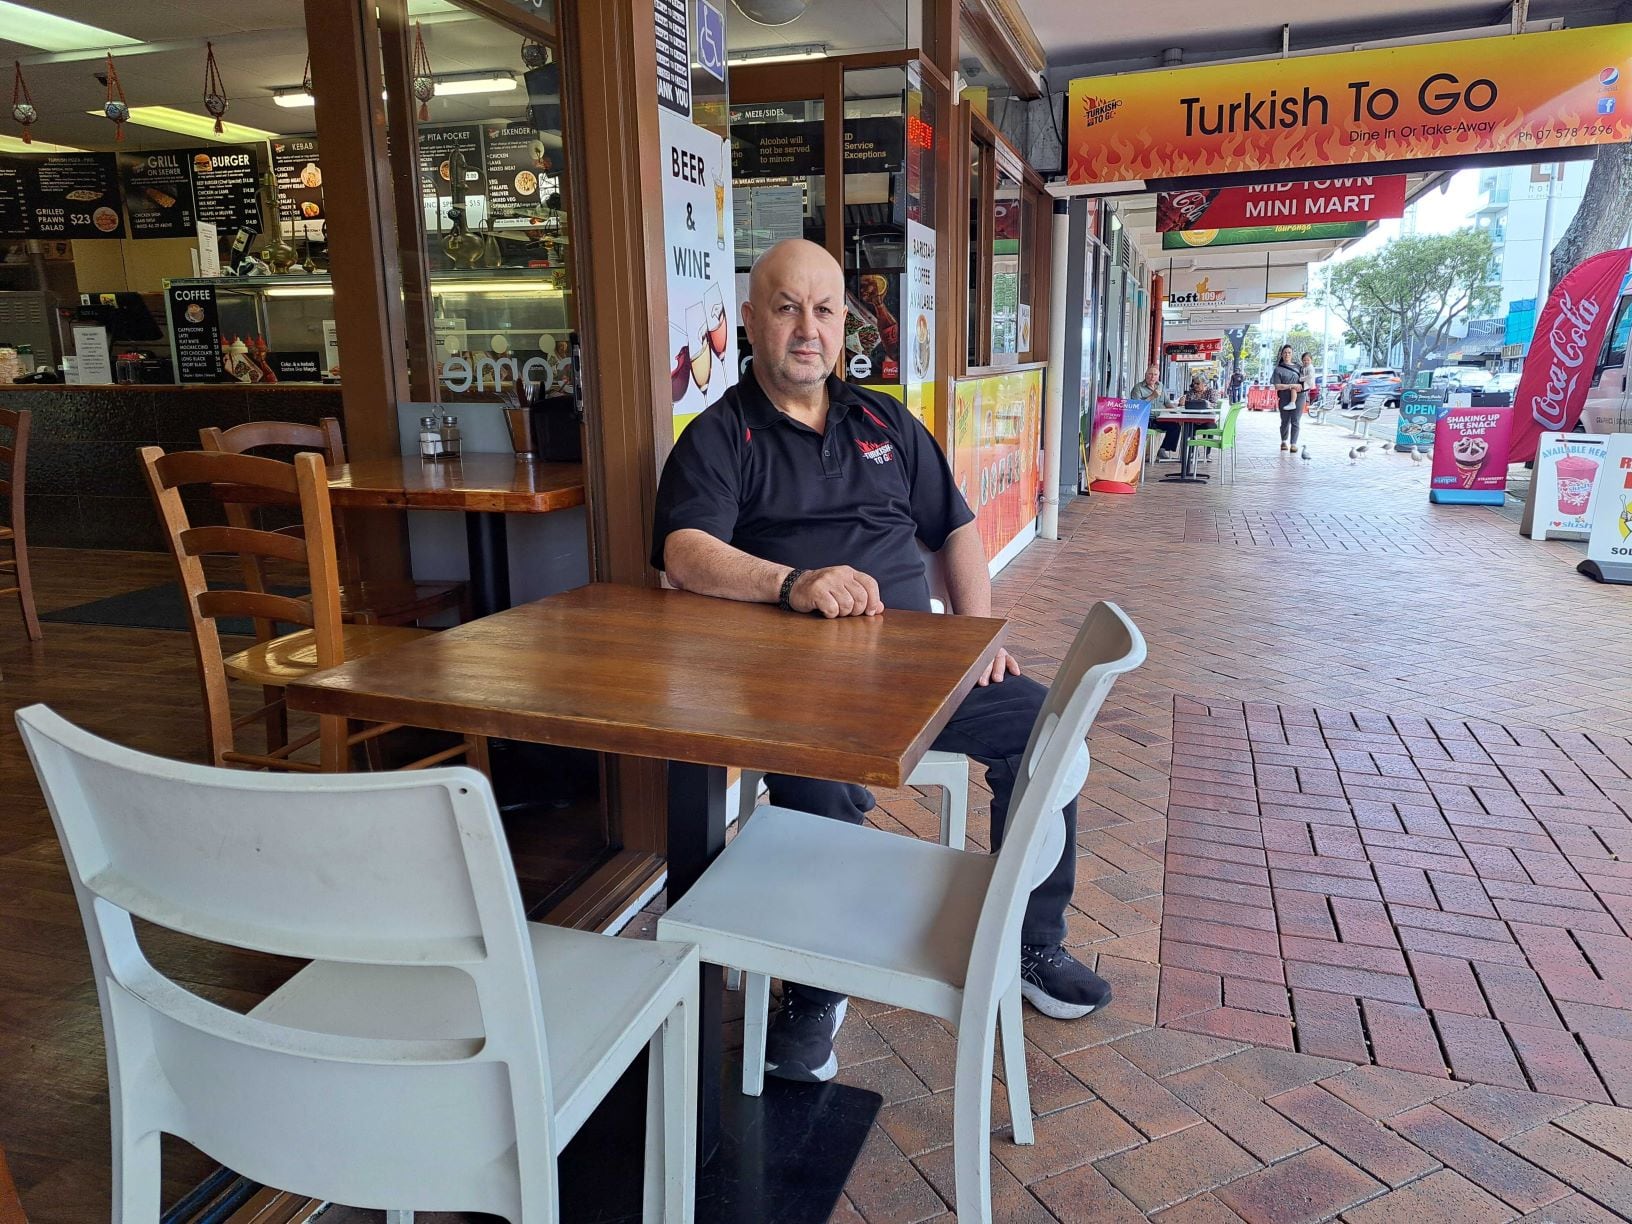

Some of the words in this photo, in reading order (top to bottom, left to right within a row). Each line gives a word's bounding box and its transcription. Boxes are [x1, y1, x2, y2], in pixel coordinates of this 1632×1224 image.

[656, 77, 674, 102] ANK
[674, 86, 688, 108] YOU
[1085, 101, 1118, 117] TURKISH
[1180, 87, 1329, 137] Turkish
[1348, 81, 1399, 122] To
[1418, 72, 1498, 116] Go
[744, 108, 785, 119] MEZE/SIDES
[1094, 113, 1105, 125] TO
[427, 133, 441, 141] PITA
[443, 131, 470, 140] POCKET
[501, 127, 530, 137] ISKENDER
[844, 133, 853, 141] ID
[1349, 128, 1381, 142] Dine
[1384, 127, 1396, 139] In
[1400, 125, 1416, 138] Or
[1421, 121, 1496, 138] Take-Away
[1518, 131, 1532, 141] Ph
[1536, 129, 1551, 140] 07
[1555, 127, 1579, 139] 578
[1582, 125, 1613, 137] 7296
[291, 142, 314, 150] KEBAB
[759, 136, 788, 146] Alcohol
[789, 136, 804, 144] will
[844, 142, 874, 150] Service
[759, 147, 773, 155] not
[774, 146, 781, 154] be
[782, 145, 810, 153] served
[844, 150, 887, 161] Exceptions
[147, 155, 179, 168] GRILL
[211, 154, 250, 167] BURGER
[759, 155, 767, 163] to
[769, 155, 795, 163] minors
[159, 168, 182, 176] SKEWER
[671, 145, 706, 187] BEER
[1247, 181, 1295, 194] MID
[1302, 176, 1374, 190] TOWN
[35, 208, 65, 216] GRILLED
[1245, 198, 1297, 218] MINI
[1304, 194, 1375, 216] MART
[38, 216, 65, 224] PRAWN
[70, 213, 91, 225] $23
[686, 201, 696, 232] &
[40, 224, 65, 232] SALAD
[672, 245, 711, 280] WINE
[913, 265, 931, 286] COFFEE
[175, 289, 211, 301] COFFEE
[909, 291, 934, 311] AVAILABLE
[1170, 293, 1199, 304] loft
[1201, 291, 1216, 301] 109
[1532, 289, 1600, 430] Coca-Cola
[1107, 400, 1140, 410] MAGNUM
[1405, 404, 1436, 415] OPEN
[1446, 414, 1486, 424] SHAKING
[1487, 413, 1500, 421] UP
[1448, 421, 1467, 430] THE
[1467, 420, 1497, 429] SNACK
[1459, 427, 1486, 435] GAME
[864, 444, 892, 460] TURKISH
[1541, 445, 1587, 459] AVAILABLE
[873, 456, 884, 465] TO
